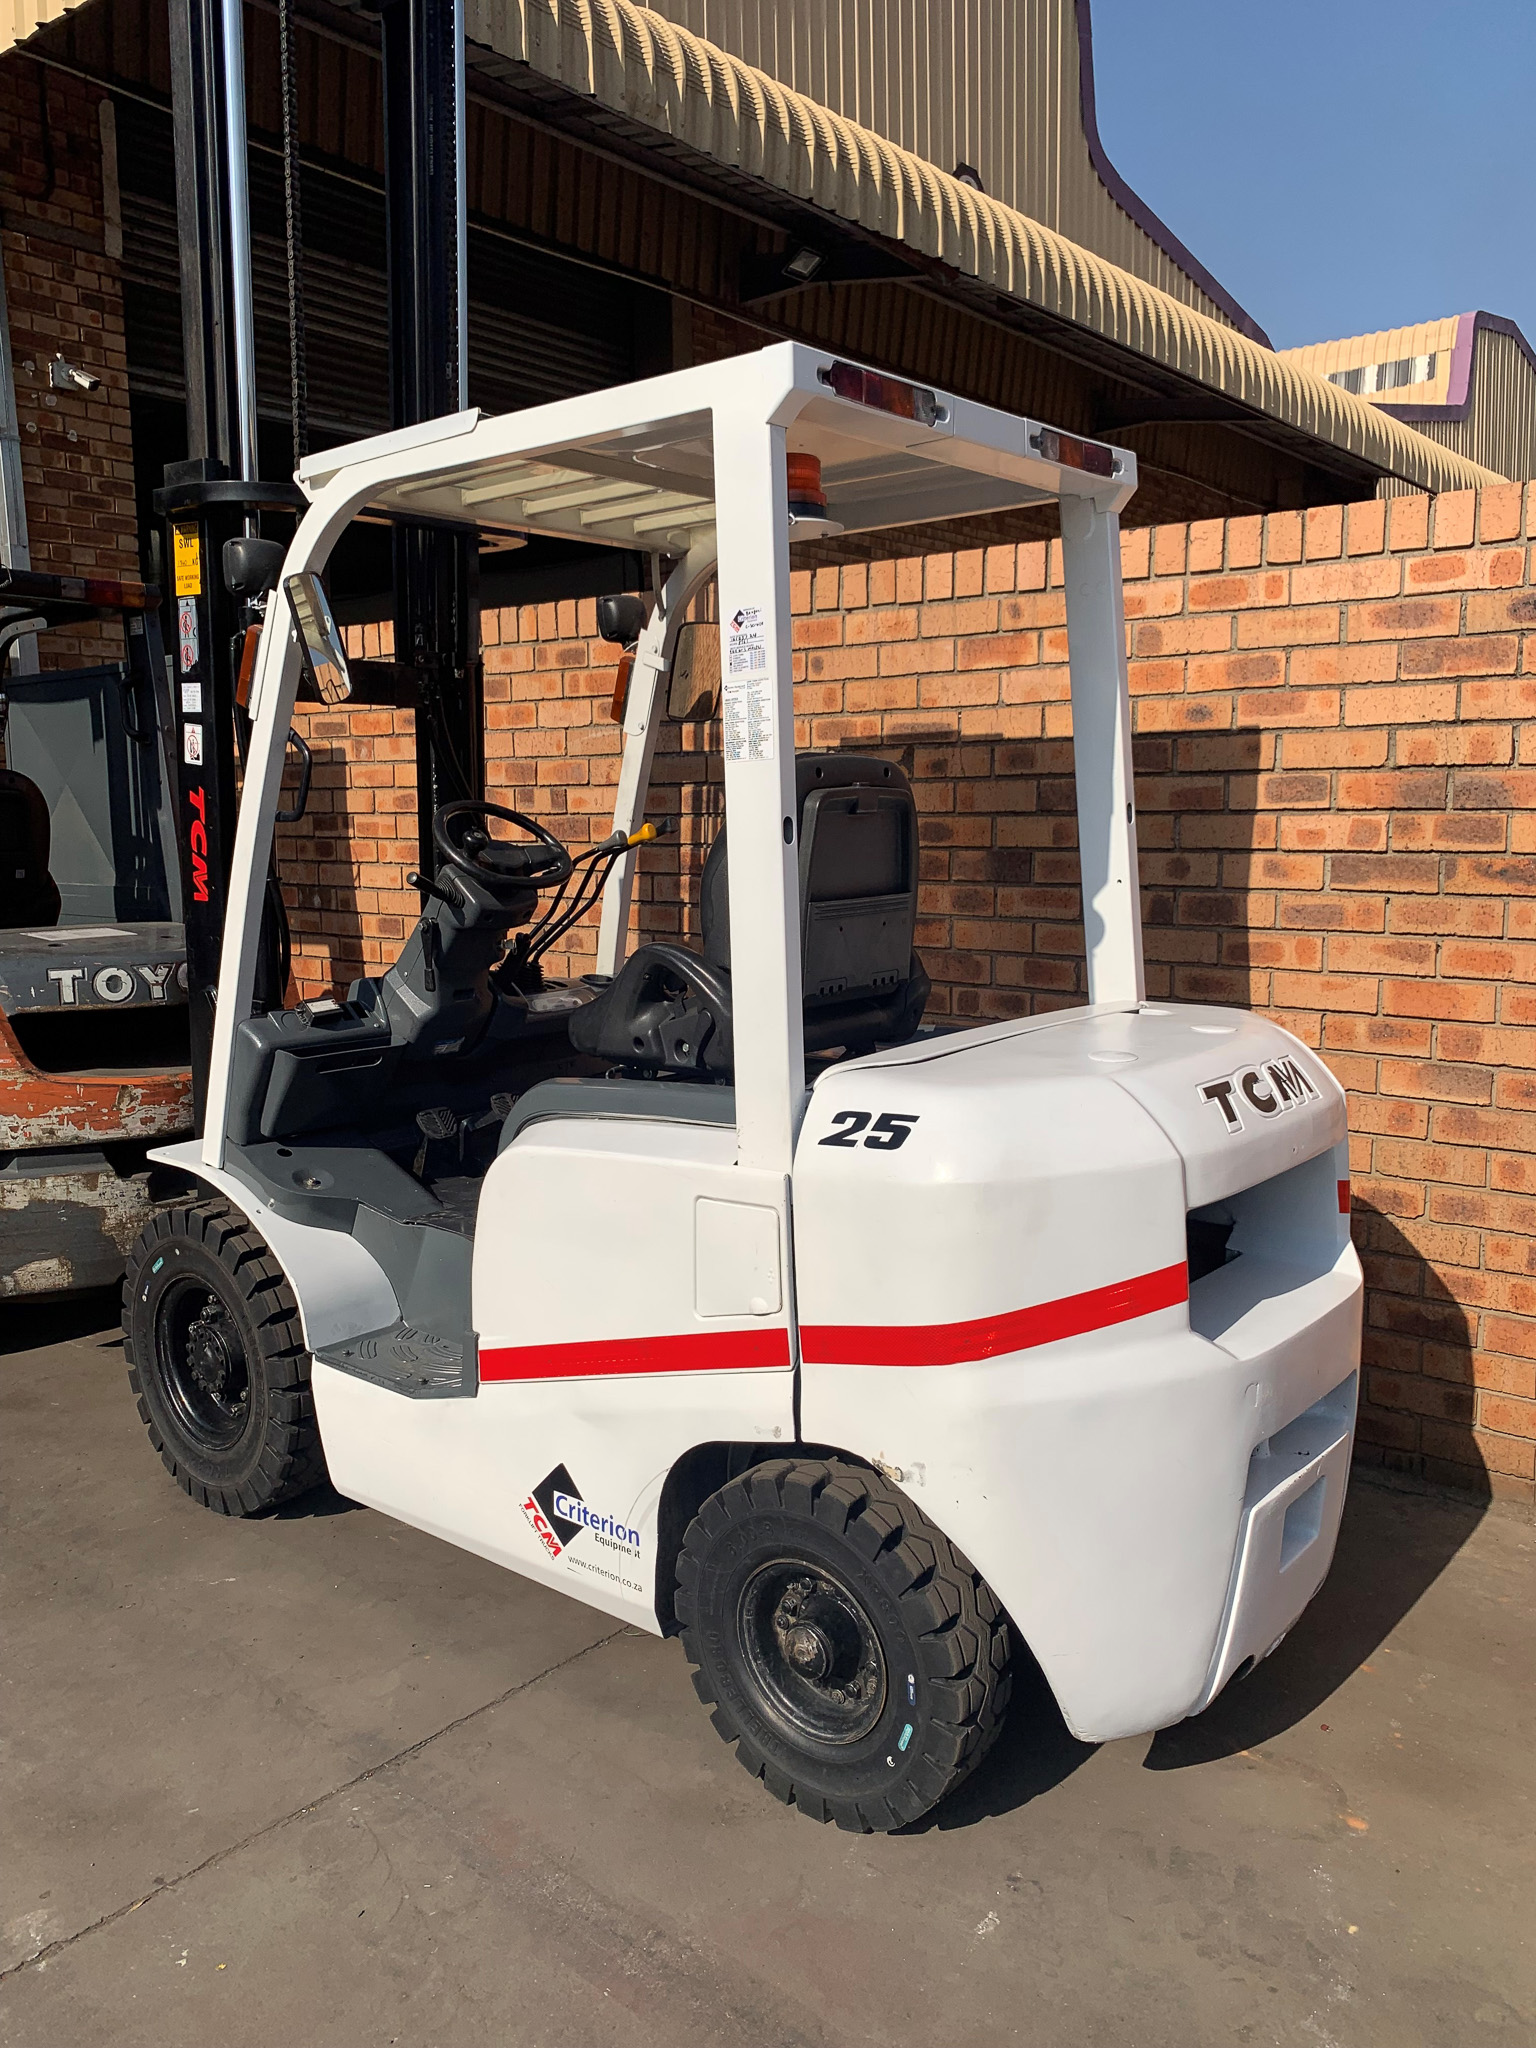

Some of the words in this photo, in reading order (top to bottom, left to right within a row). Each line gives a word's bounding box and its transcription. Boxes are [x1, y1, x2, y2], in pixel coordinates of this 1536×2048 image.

[179, 538, 194, 549] SWL
[189, 786, 209, 901] TCM
[47, 962, 188, 1006] TOY
[1198, 1057, 1319, 1131] TCM
[817, 1110, 921, 1151] 25
[518, 1503, 537, 1534] FORKLIFT
[538, 1535, 556, 1561] TRUCKS
[523, 1496, 562, 1558] TCM
[555, 1495, 641, 1547] Criterion
[567, 1555, 643, 1592] www.criterion.co.za
